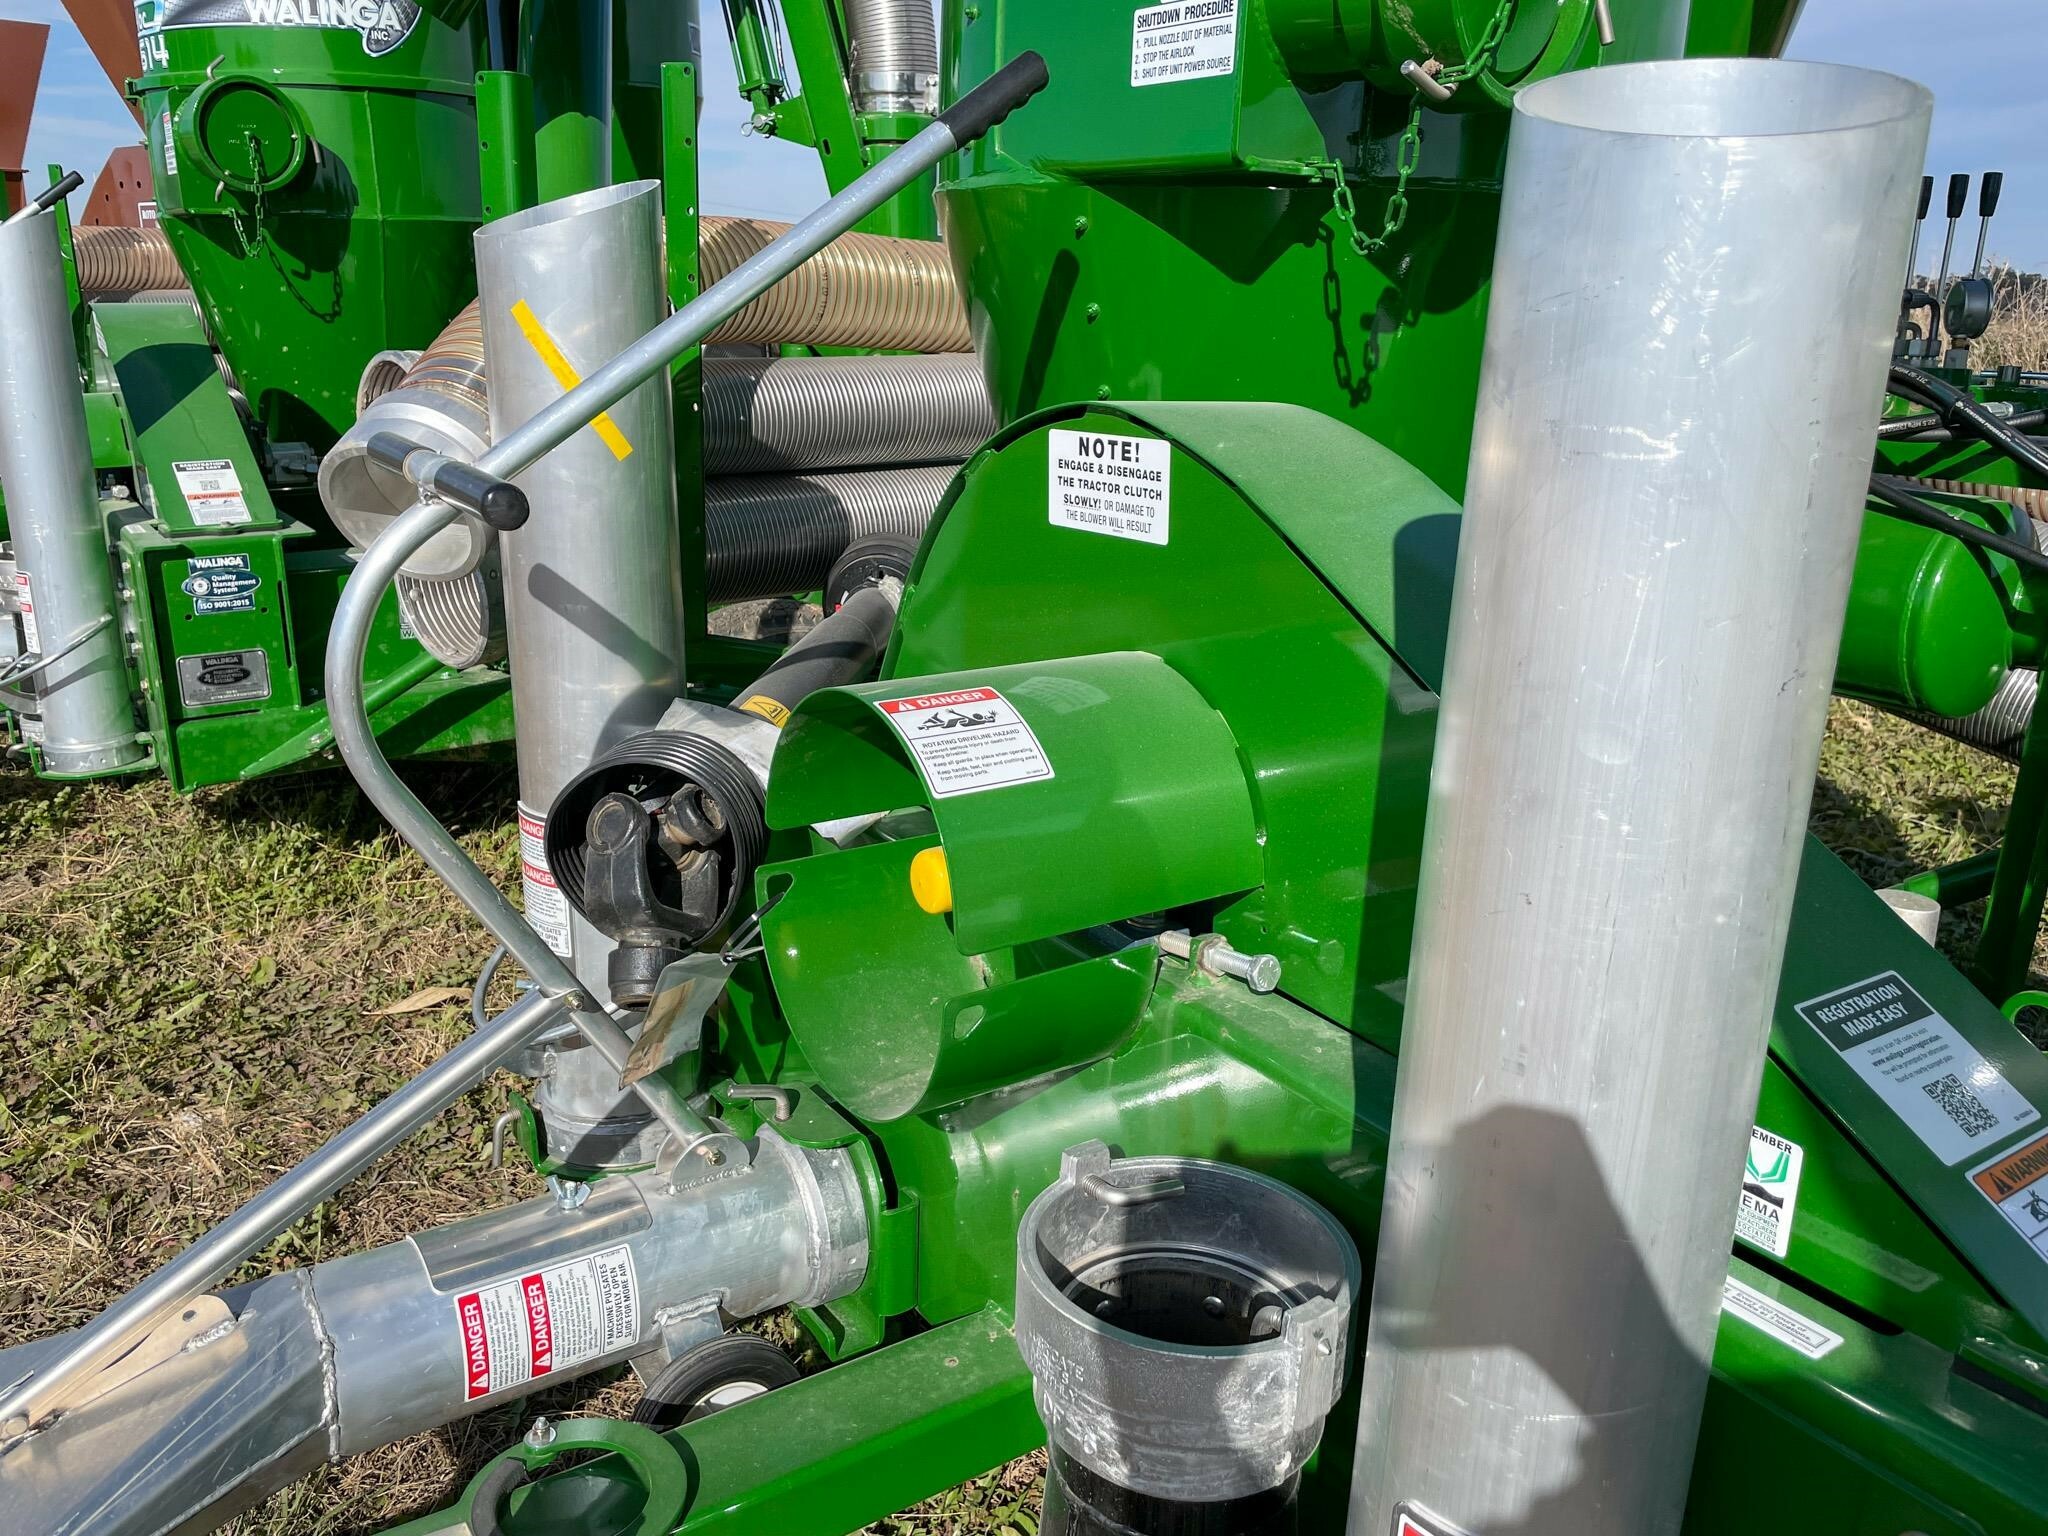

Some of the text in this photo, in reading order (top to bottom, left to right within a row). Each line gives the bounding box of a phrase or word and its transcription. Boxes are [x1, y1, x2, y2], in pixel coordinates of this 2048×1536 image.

[250, 0, 402, 41] WALINGA INC.
[1137, 0, 1233, 29] SHUTDOWN PROCEDURE
[1143, 37, 1158, 48] PULL
[1159, 32, 1180, 44] NOZZLE
[1181, 30, 1193, 41] OUT
[1194, 28, 1202, 40] OF
[1203, 23, 1232, 38] MATERIAL
[1143, 51, 1158, 63] STOP
[1159, 49, 1169, 60] THE
[1170, 46, 1195, 59] AIRLOCK
[1142, 67, 1157, 79] SHUT
[1158, 65, 1168, 76] OFF
[1169, 63, 1182, 75] UNIT
[1184, 60, 1206, 72] POWER
[1206, 56, 1231, 69] SOURCE
[1079, 436, 1140, 463] NOTE!
[1058, 459, 1162, 482] ENGAGE & DISENGAGE
[1057, 475, 1162, 501] THE TRACTOR CLUTCH
[1063, 493, 1155, 518] SLOWLY! OR DAMAGE TO
[1066, 509, 1152, 534] THE BLOWER WILL RESULT
[194, 556, 244, 568] WALINGA
[211, 574, 237, 584] Quality
[211, 579, 256, 588] Management
[213, 587, 238, 595] System
[200, 599, 250, 610] ISO 9001:2015
[917, 692, 986, 707] DANGER
[922, 729, 1020, 748] ROTATING DRIVELINE HAZARD
[522, 819, 545, 837] DANG
[1815, 983, 1902, 1024] REGISTRATION
[1841, 1002, 1908, 1036] MADE EASY
[1751, 1128, 1793, 1155] EMBER
[2001, 1143, 2048, 1184] WARNIN
[1742, 1193, 1780, 1223] EMA
[1737, 1213, 1777, 1238] NUFACTURERS
[1737, 1221, 1776, 1245] SOCIATION
[600, 1263, 612, 1303] PULSATES
[610, 1267, 620, 1290] OPEN
[621, 1278, 631, 1302] MORE
[547, 1280, 555, 1307] HAZARD
[528, 1282, 551, 1351] DANGER
[605, 1306, 614, 1339] MACHINE
[624, 1303, 632, 1319] FOR
[464, 1302, 488, 1373] DANGER
[624, 1319, 632, 1338] SLIDE
